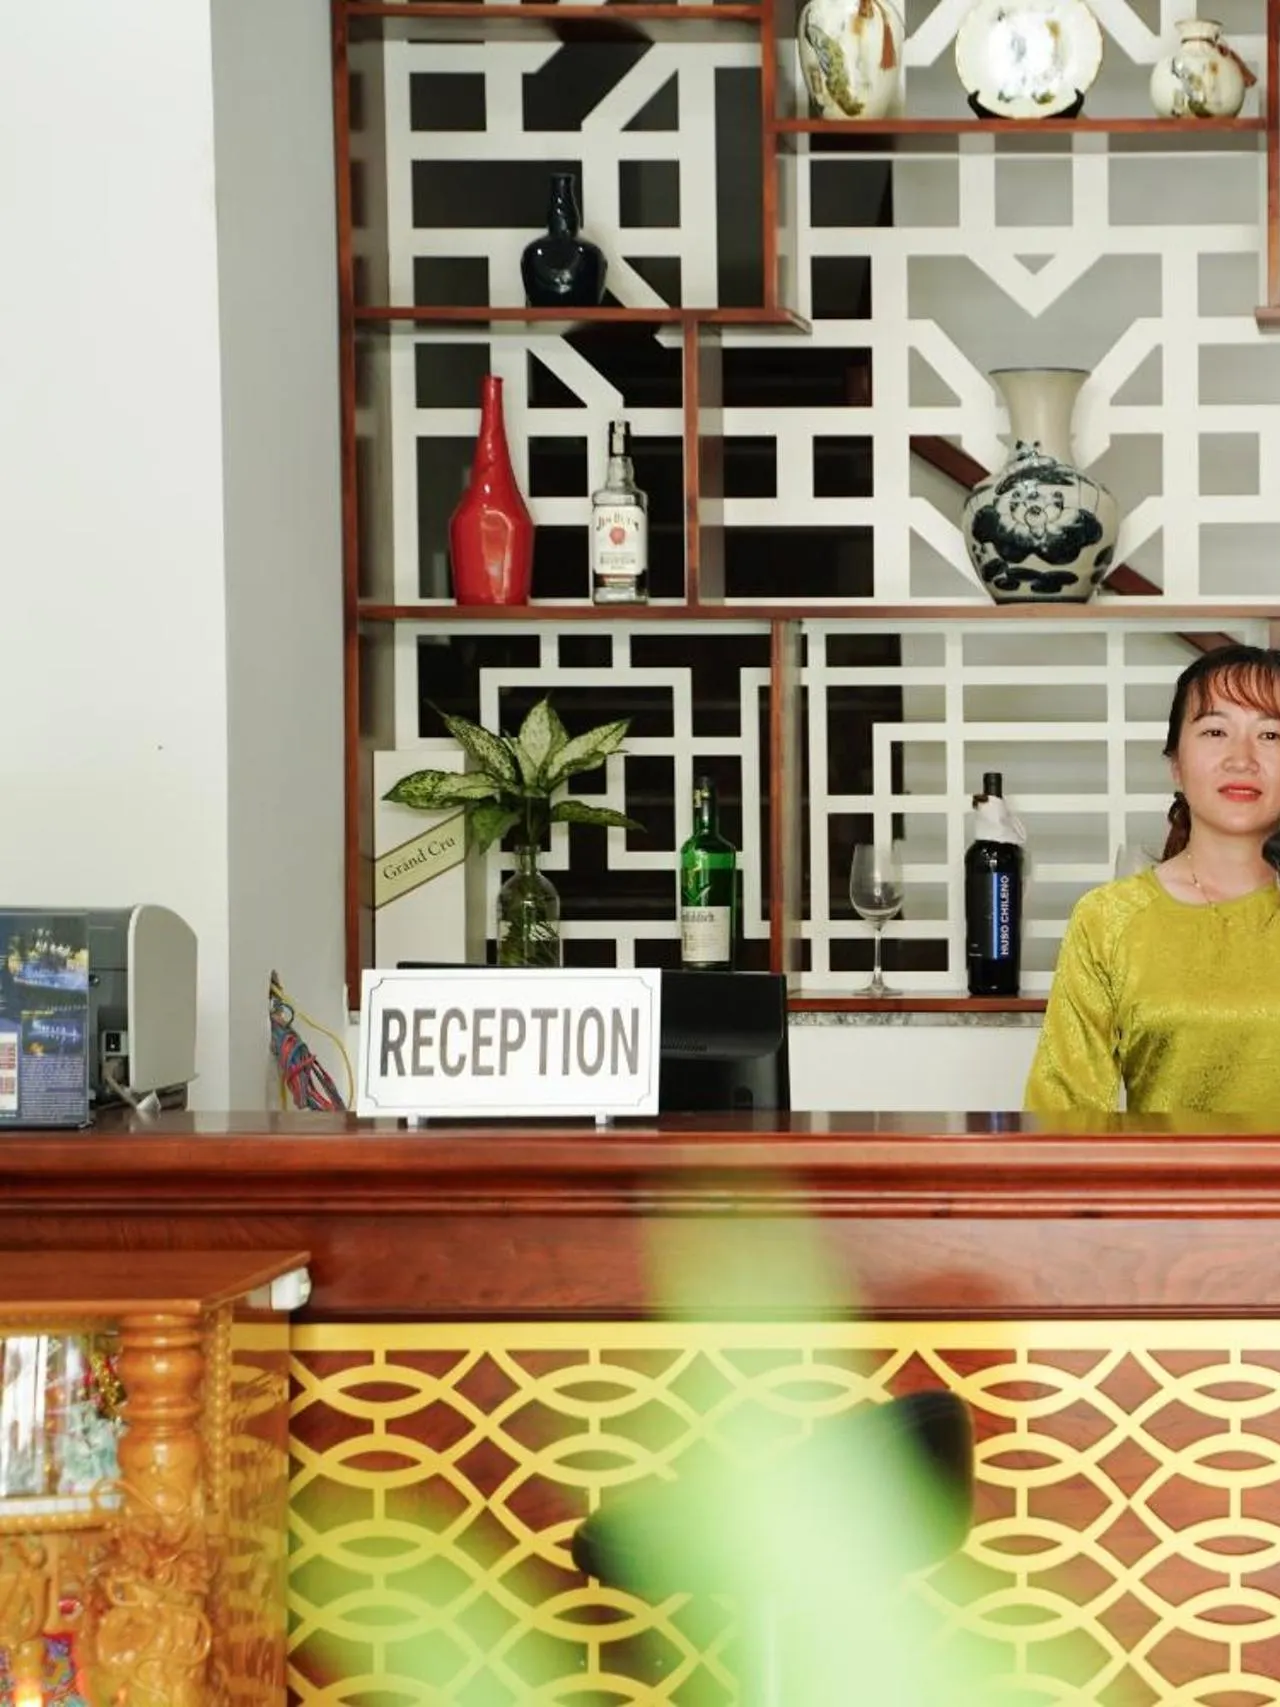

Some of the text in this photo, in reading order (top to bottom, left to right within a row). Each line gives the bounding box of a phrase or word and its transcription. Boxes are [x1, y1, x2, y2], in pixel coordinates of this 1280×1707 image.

[382, 836, 456, 881] Grand Cru
[1000, 875, 1010, 923] CHILENO
[380, 1006, 640, 1077] RECEPTION
